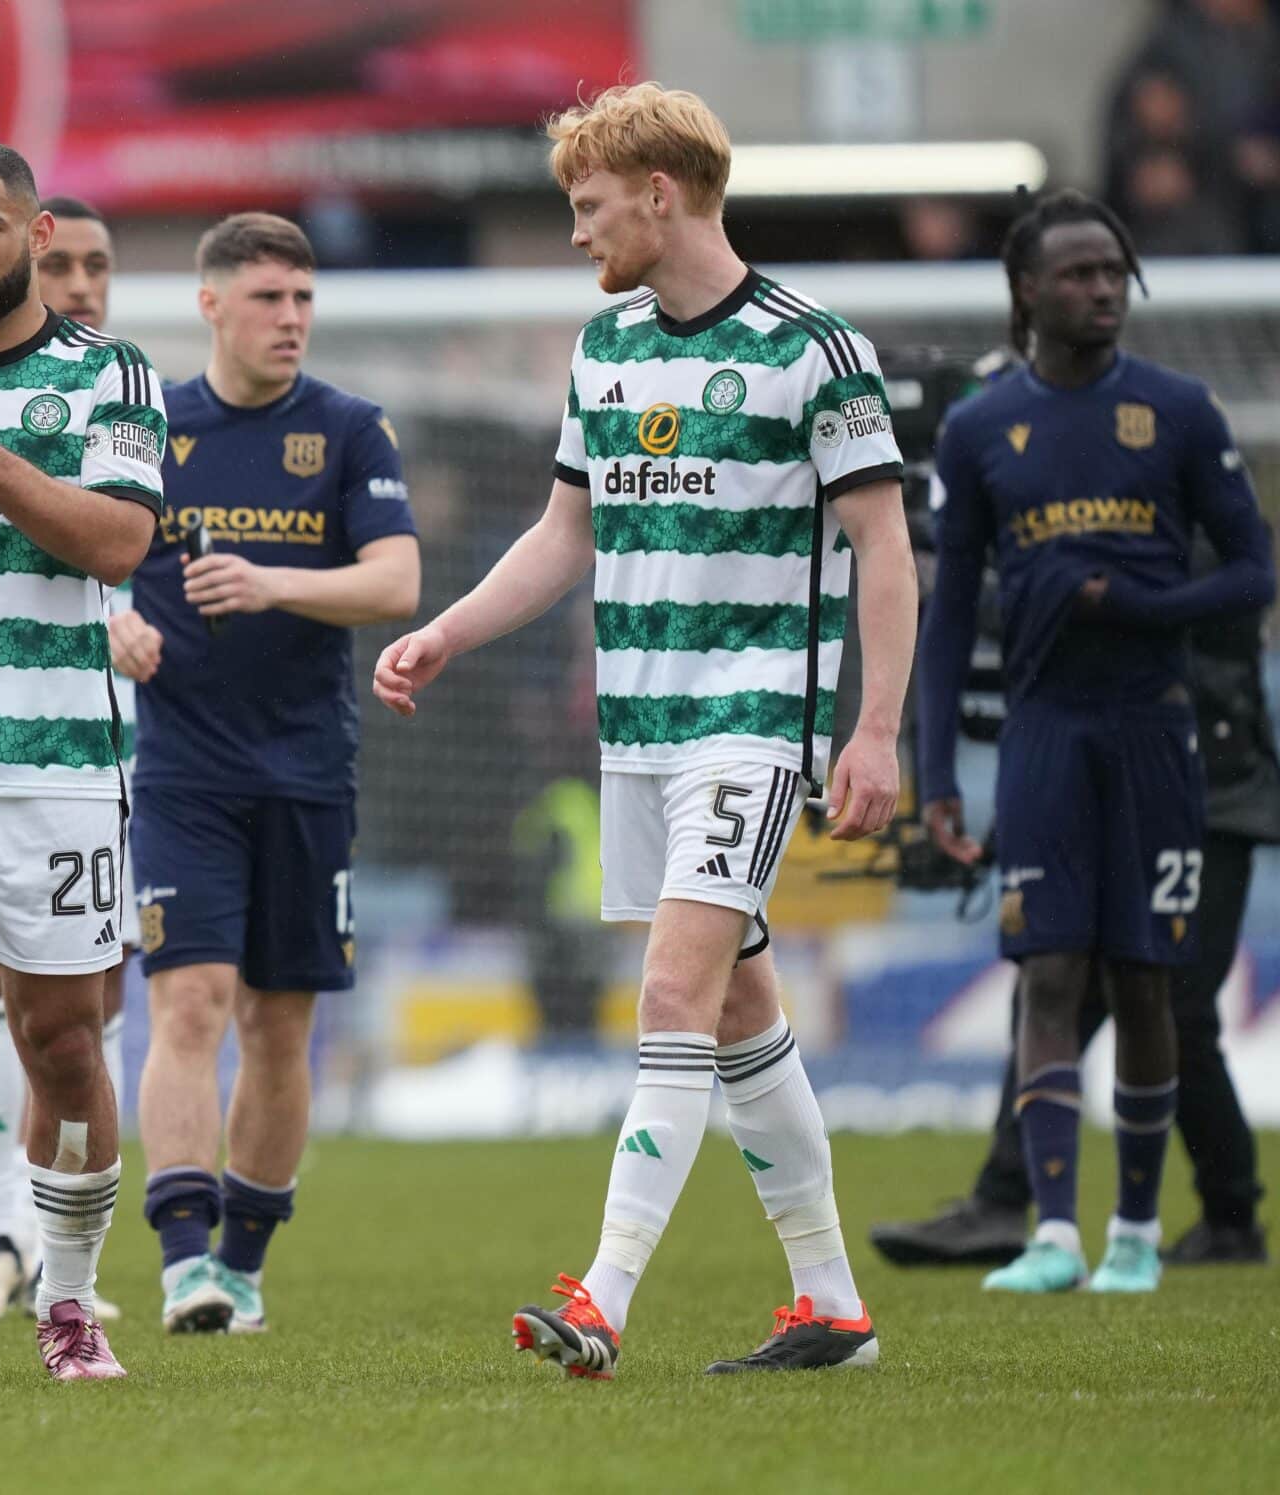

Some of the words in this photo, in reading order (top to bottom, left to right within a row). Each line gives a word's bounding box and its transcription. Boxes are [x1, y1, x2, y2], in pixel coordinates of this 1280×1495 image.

[112, 422, 147, 446] CELTIC
[605, 461, 716, 500] dafabet
[705, 784, 753, 849] 5
[49, 847, 116, 917] 20
[1151, 849, 1204, 914] 23
